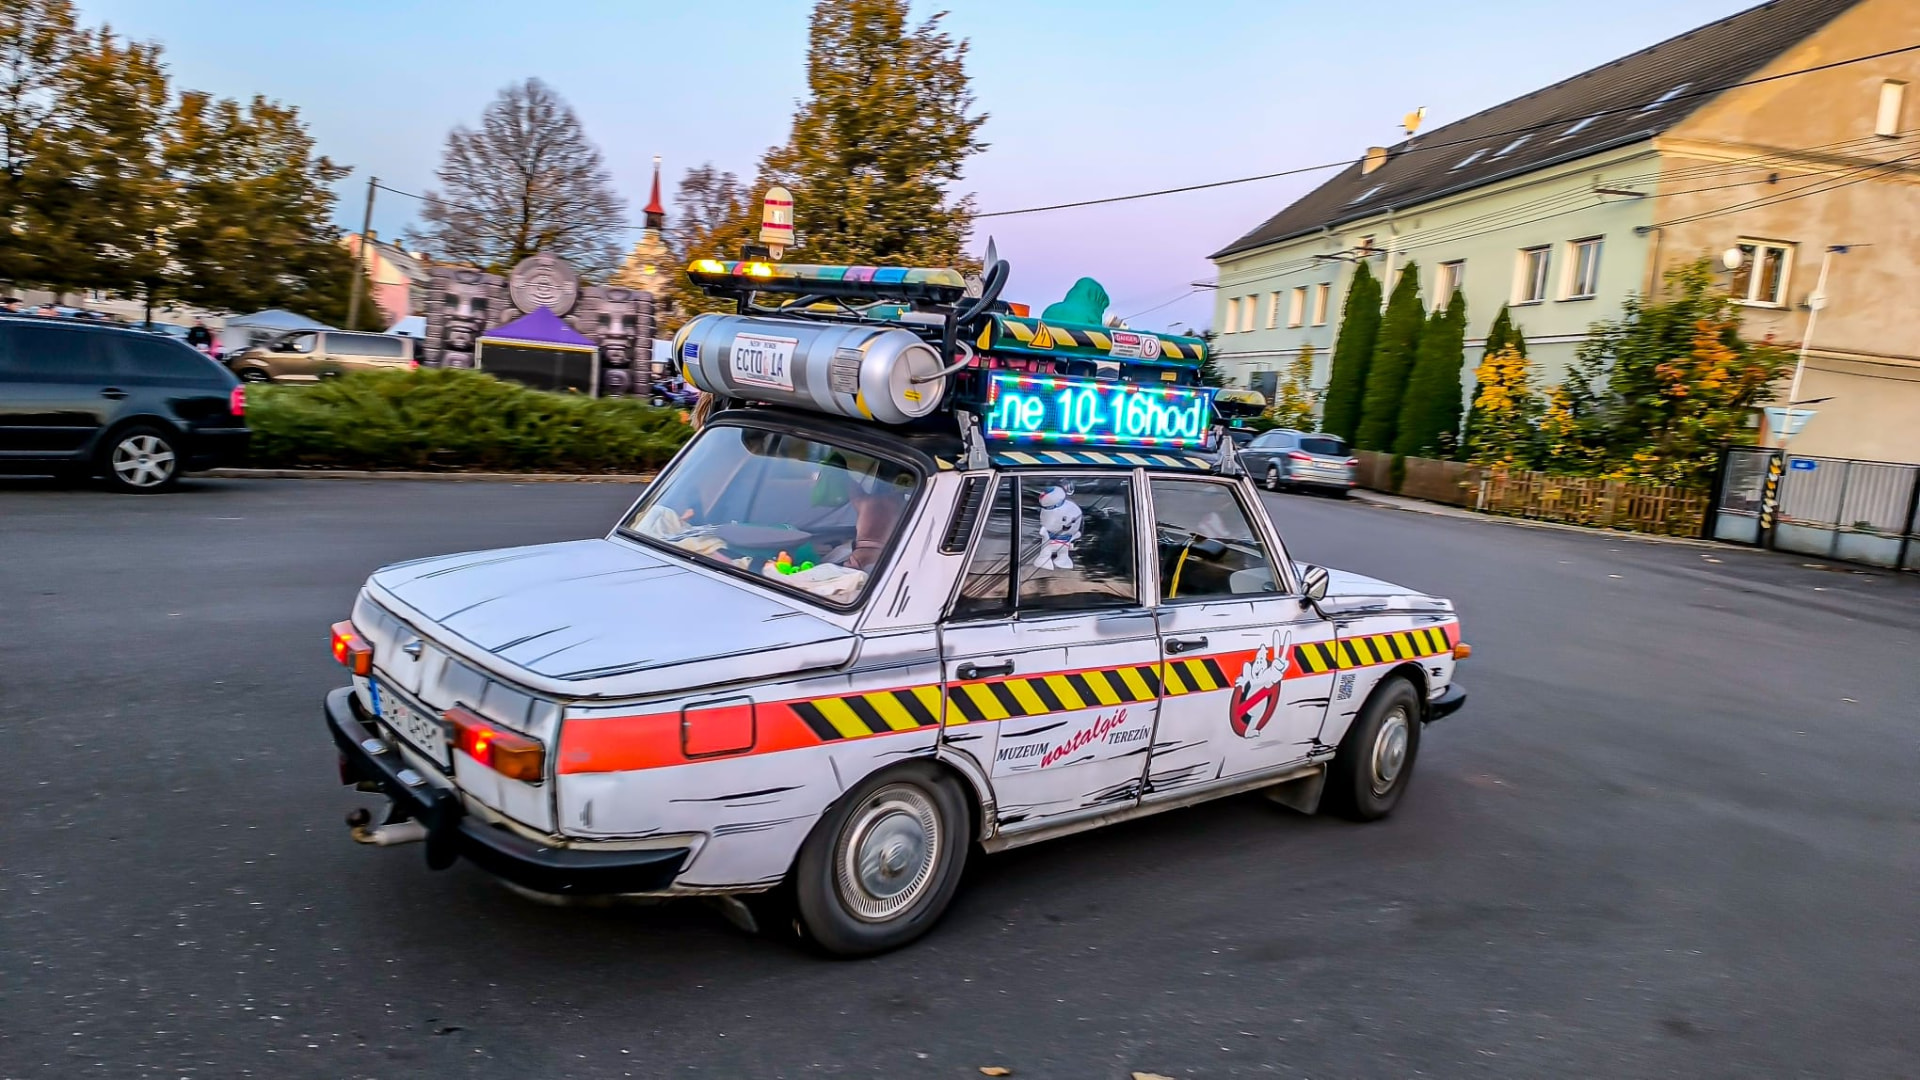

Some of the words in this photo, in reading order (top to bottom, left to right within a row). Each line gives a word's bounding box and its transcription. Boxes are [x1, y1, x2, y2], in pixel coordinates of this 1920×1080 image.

[736, 347, 763, 375] ECTO
[996, 742, 1050, 762] MUZEUM
[1040, 708, 1128, 768] nostalgie
[1108, 725, 1151, 745] TEREZÍN
